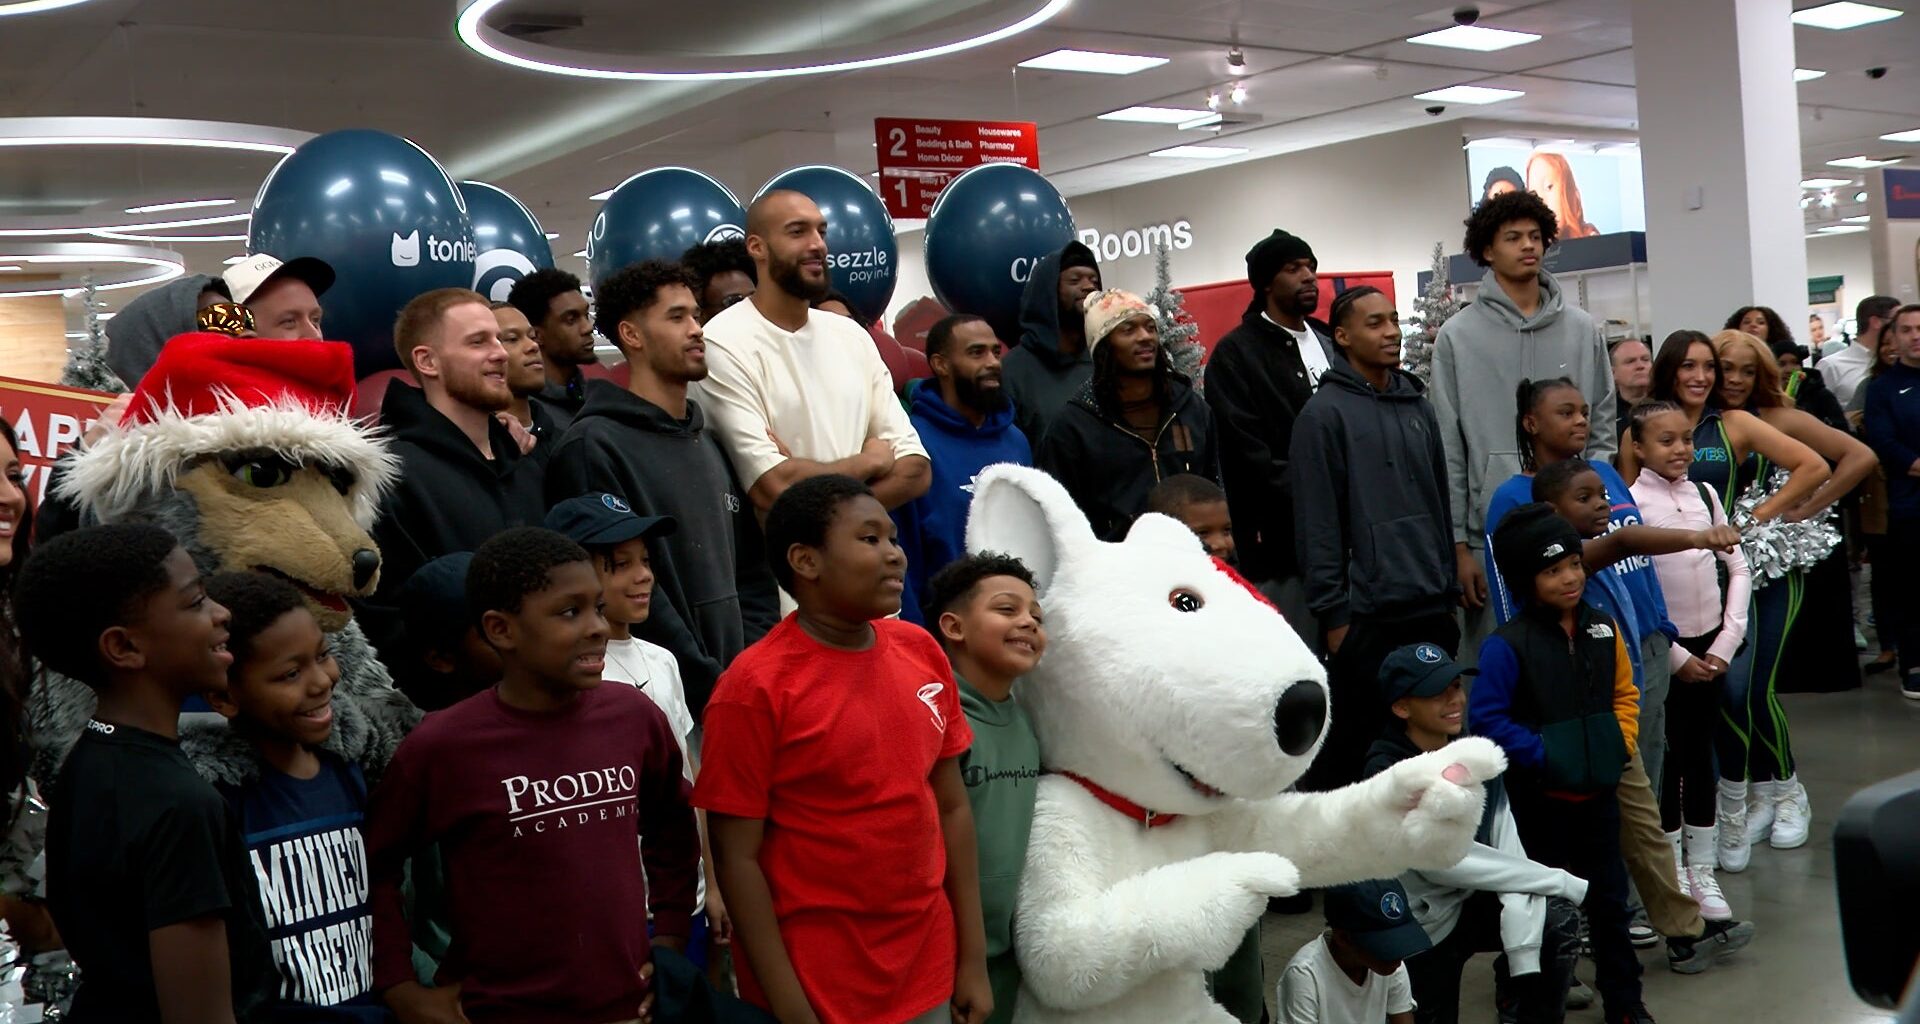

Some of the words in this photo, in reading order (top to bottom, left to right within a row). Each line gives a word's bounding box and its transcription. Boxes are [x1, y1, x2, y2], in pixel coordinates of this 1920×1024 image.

[915, 124, 941, 135] Beauty
[978, 126, 1022, 137] Housewares
[889, 127, 907, 156] 2
[916, 139, 947, 150] Bedding
[948, 140, 954, 149] &
[955, 140, 973, 149] Bath
[979, 140, 1015, 152] Pharmacy
[917, 153, 940, 162] Home
[980, 154, 1028, 164] Womenswear
[894, 178, 907, 207] 1
[1078, 219, 1194, 263] Rooms
[825, 245, 887, 269] sezzle
[849, 271, 873, 286] pay
[501, 765, 636, 814] PRODEO
